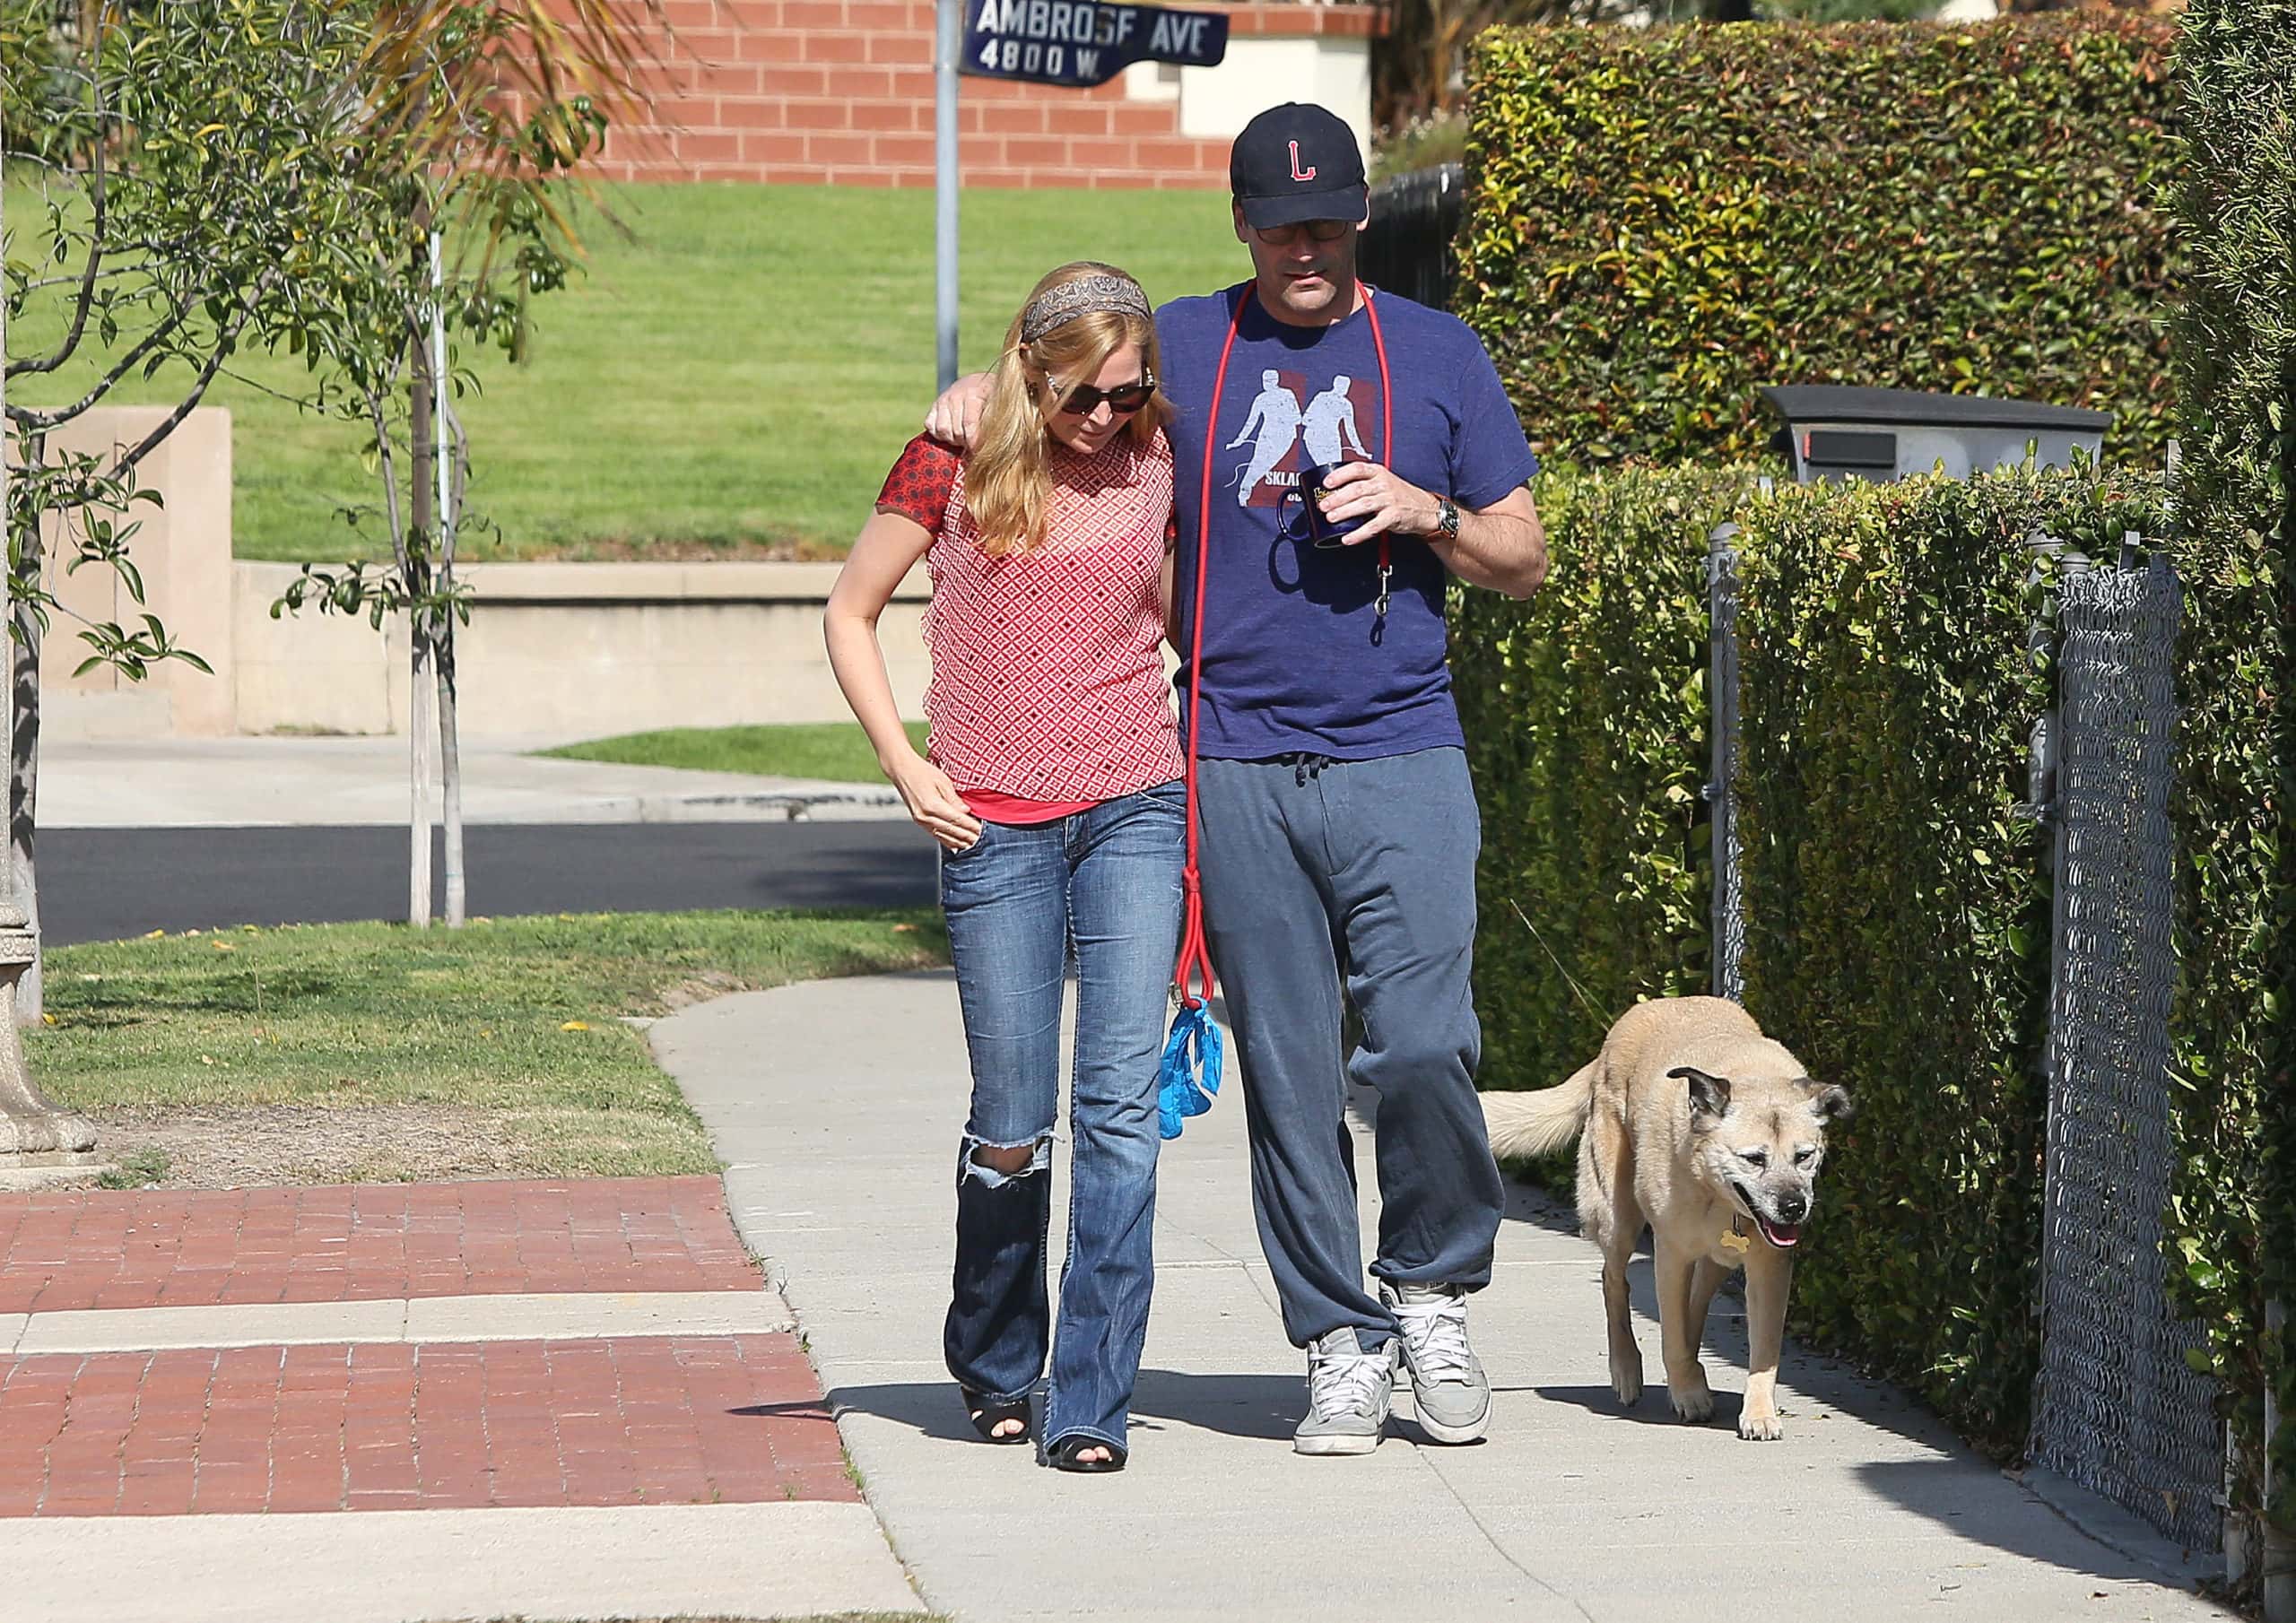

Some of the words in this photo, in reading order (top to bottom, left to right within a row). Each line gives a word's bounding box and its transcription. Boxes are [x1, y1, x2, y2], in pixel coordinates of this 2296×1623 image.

[1150, 14, 1209, 56] AVE
[979, 39, 1064, 76] 4800
[1288, 140, 1317, 182] L
